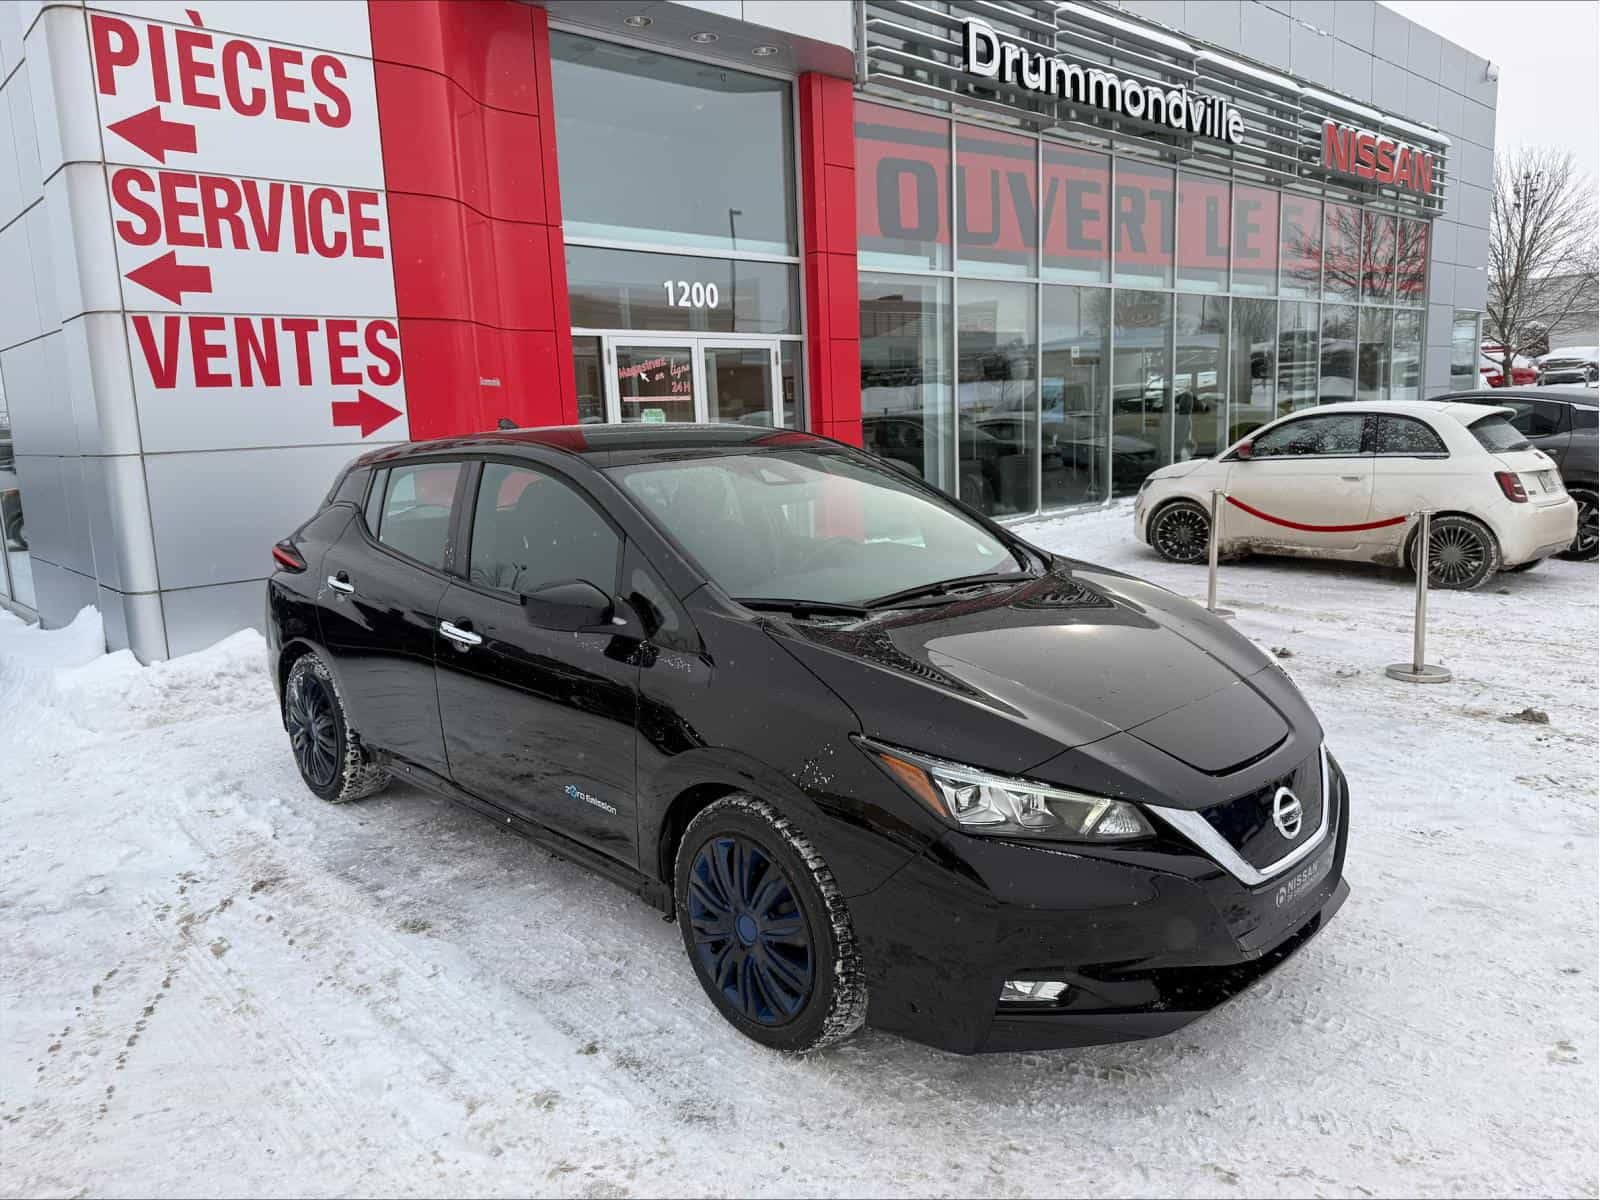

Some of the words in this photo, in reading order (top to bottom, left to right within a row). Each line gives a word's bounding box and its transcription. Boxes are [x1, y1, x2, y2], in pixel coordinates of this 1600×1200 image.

[91, 9, 352, 128] PIÈCES
[962, 17, 1245, 145] Drummondville
[1321, 119, 1433, 194] NISSAN
[111, 168, 385, 259] SERVICE
[876, 157, 1183, 254] OUVERT
[1206, 196, 1263, 258] LE
[664, 280, 718, 309] 1200
[132, 315, 402, 389] VENTES
[1287, 860, 1319, 893] NISSAN
